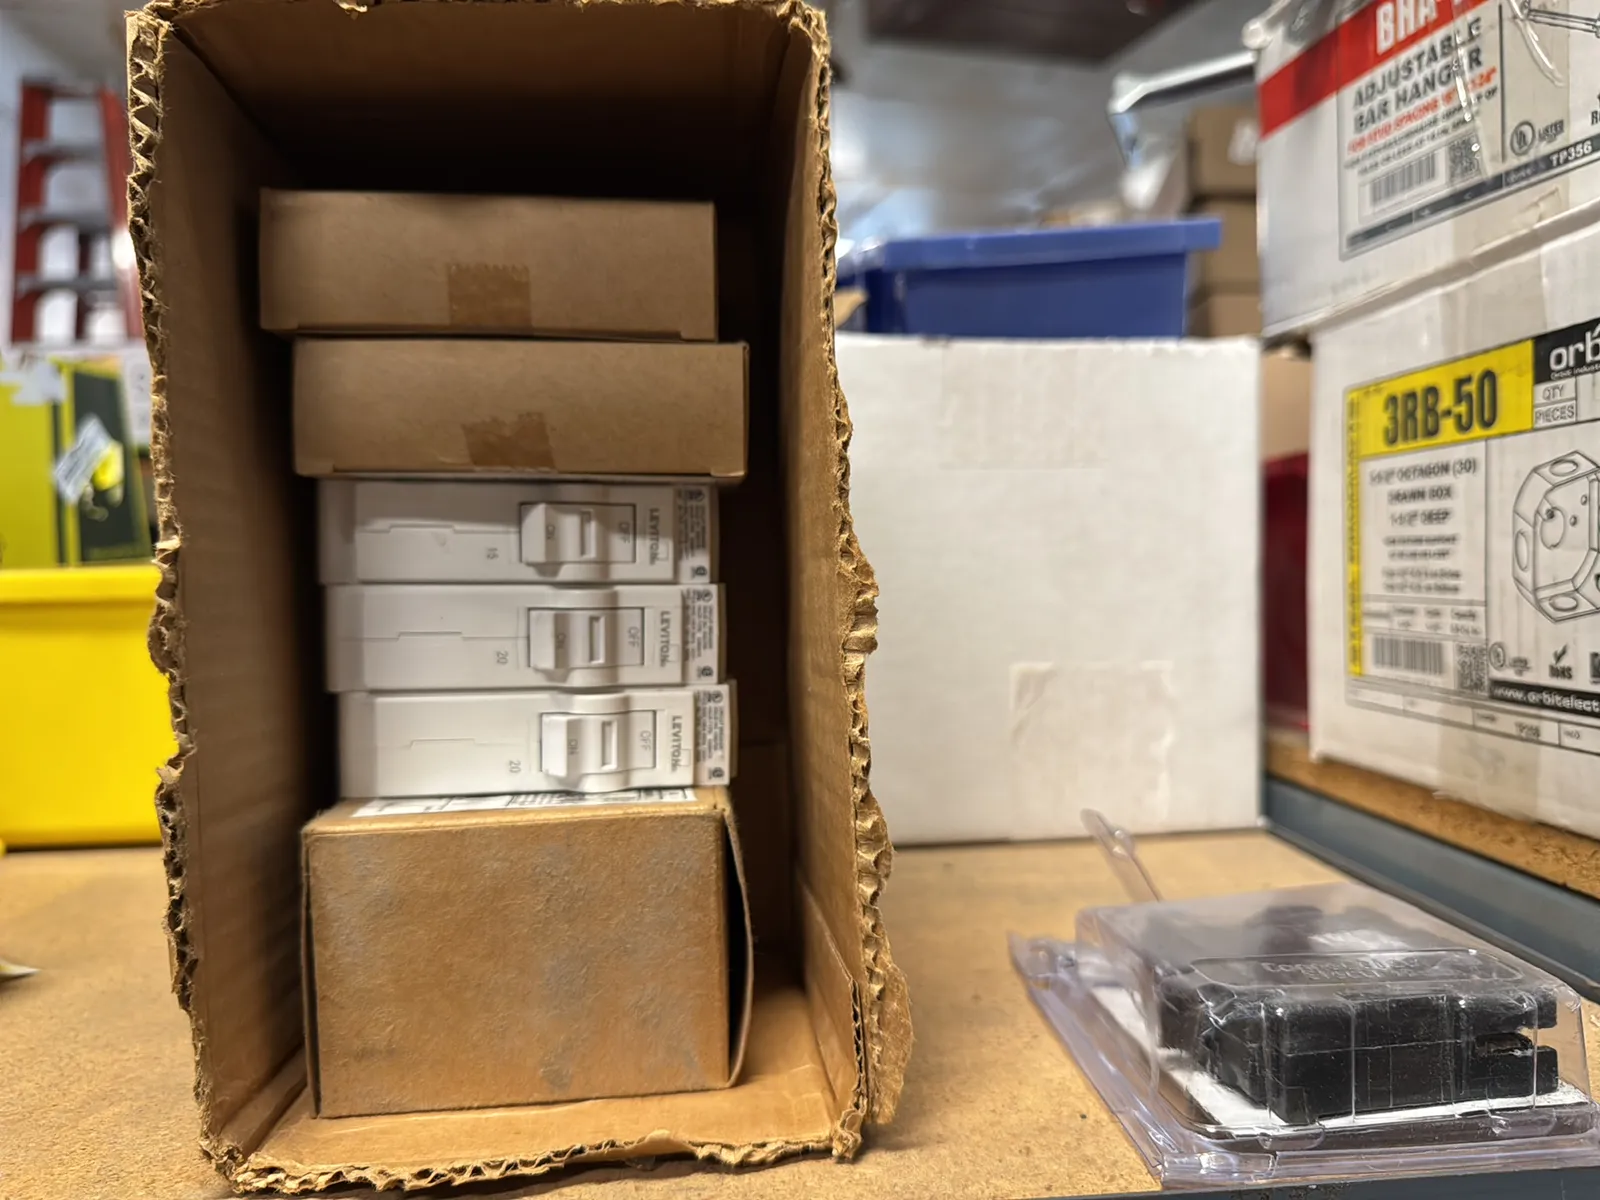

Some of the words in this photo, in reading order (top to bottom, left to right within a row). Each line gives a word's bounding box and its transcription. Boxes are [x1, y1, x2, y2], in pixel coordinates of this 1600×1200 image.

[1376, 0, 1441, 55] BHA
[1354, 17, 1482, 108] ADJUSTABLE
[1354, 100, 1389, 133] BAR
[1542, 384, 1564, 401] QTY
[1383, 369, 1498, 447] 3RB-50
[1534, 405, 1575, 424] PIECES
[1396, 460, 1451, 482] OCTAGON
[546, 523, 556, 541] ON
[618, 520, 631, 544] OFF
[557, 632, 567, 649] ON
[627, 626, 640, 648] OFF
[659, 610, 671, 667] LEVITON
[496, 650, 509, 665] 20
[568, 738, 579, 755] ON
[639, 729, 651, 752] OFF
[671, 715, 682, 772] LEVITON
[509, 759, 521, 774] 20
